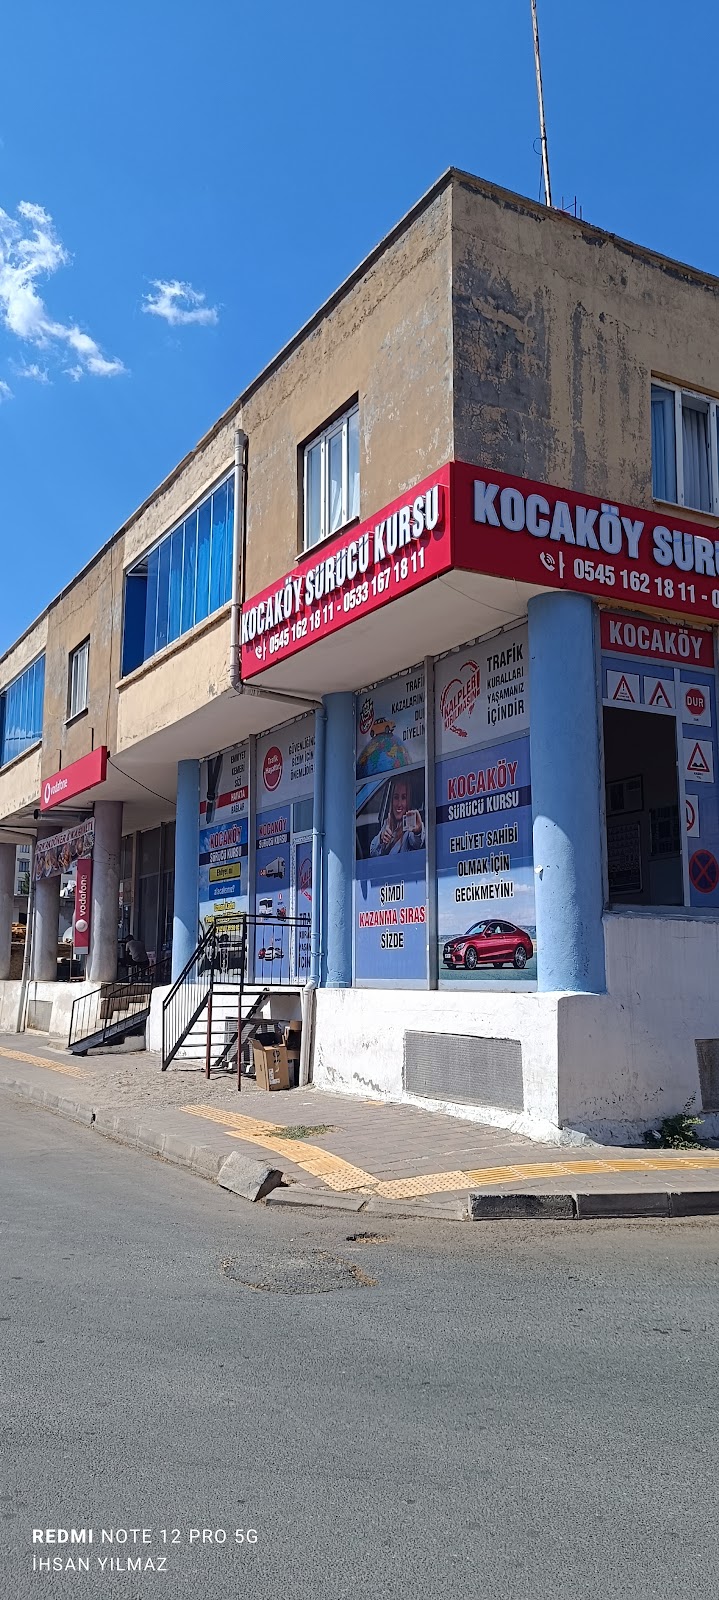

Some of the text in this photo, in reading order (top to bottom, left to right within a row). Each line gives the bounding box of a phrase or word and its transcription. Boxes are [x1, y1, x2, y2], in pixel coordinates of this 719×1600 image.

[473, 479, 645, 560] KOCAKÖY
[242, 484, 439, 645] KOCAKÖY SÜRÜCÜ KURSU
[573, 558, 615, 586] 0545
[620, 569, 650, 594] 162
[655, 577, 674, 599] 18
[678, 582, 696, 603] 11
[269, 632, 290, 655] 0545
[292, 620, 307, 642] 162
[309, 612, 321, 632] 18
[323, 604, 334, 623] 11
[343, 582, 369, 613] 0533
[371, 568, 391, 596] 167
[394, 558, 408, 583] 18
[411, 547, 425, 573] 11
[609, 620, 703, 660] KOCAKÖY
[486, 643, 524, 673] TRAFİK
[406, 673, 425, 693] TRAFİ
[487, 666, 524, 690] KURALLARI
[487, 683, 525, 704] YAŞAMANIZ
[686, 696, 704, 708] DUR
[414, 708, 425, 721] DU
[487, 697, 525, 726] İÇİNDİR
[50, 778, 68, 796] vodafone
[448, 758, 519, 801] KOCAKÖY
[448, 791, 519, 821] SÜRÜCÜ KURSU
[210, 824, 242, 849] KOCAKÖY
[450, 822, 518, 853] EHLİYET SAHİBİ
[457, 852, 511, 878] OLMAK İÇİN
[79, 873, 88, 917] vodafone
[380, 881, 404, 907] ŞİMDİ
[455, 881, 514, 904] GECİKMEYİN!
[359, 904, 427, 928] KAZANMA SIRAS
[380, 929, 404, 949] SİZDE
